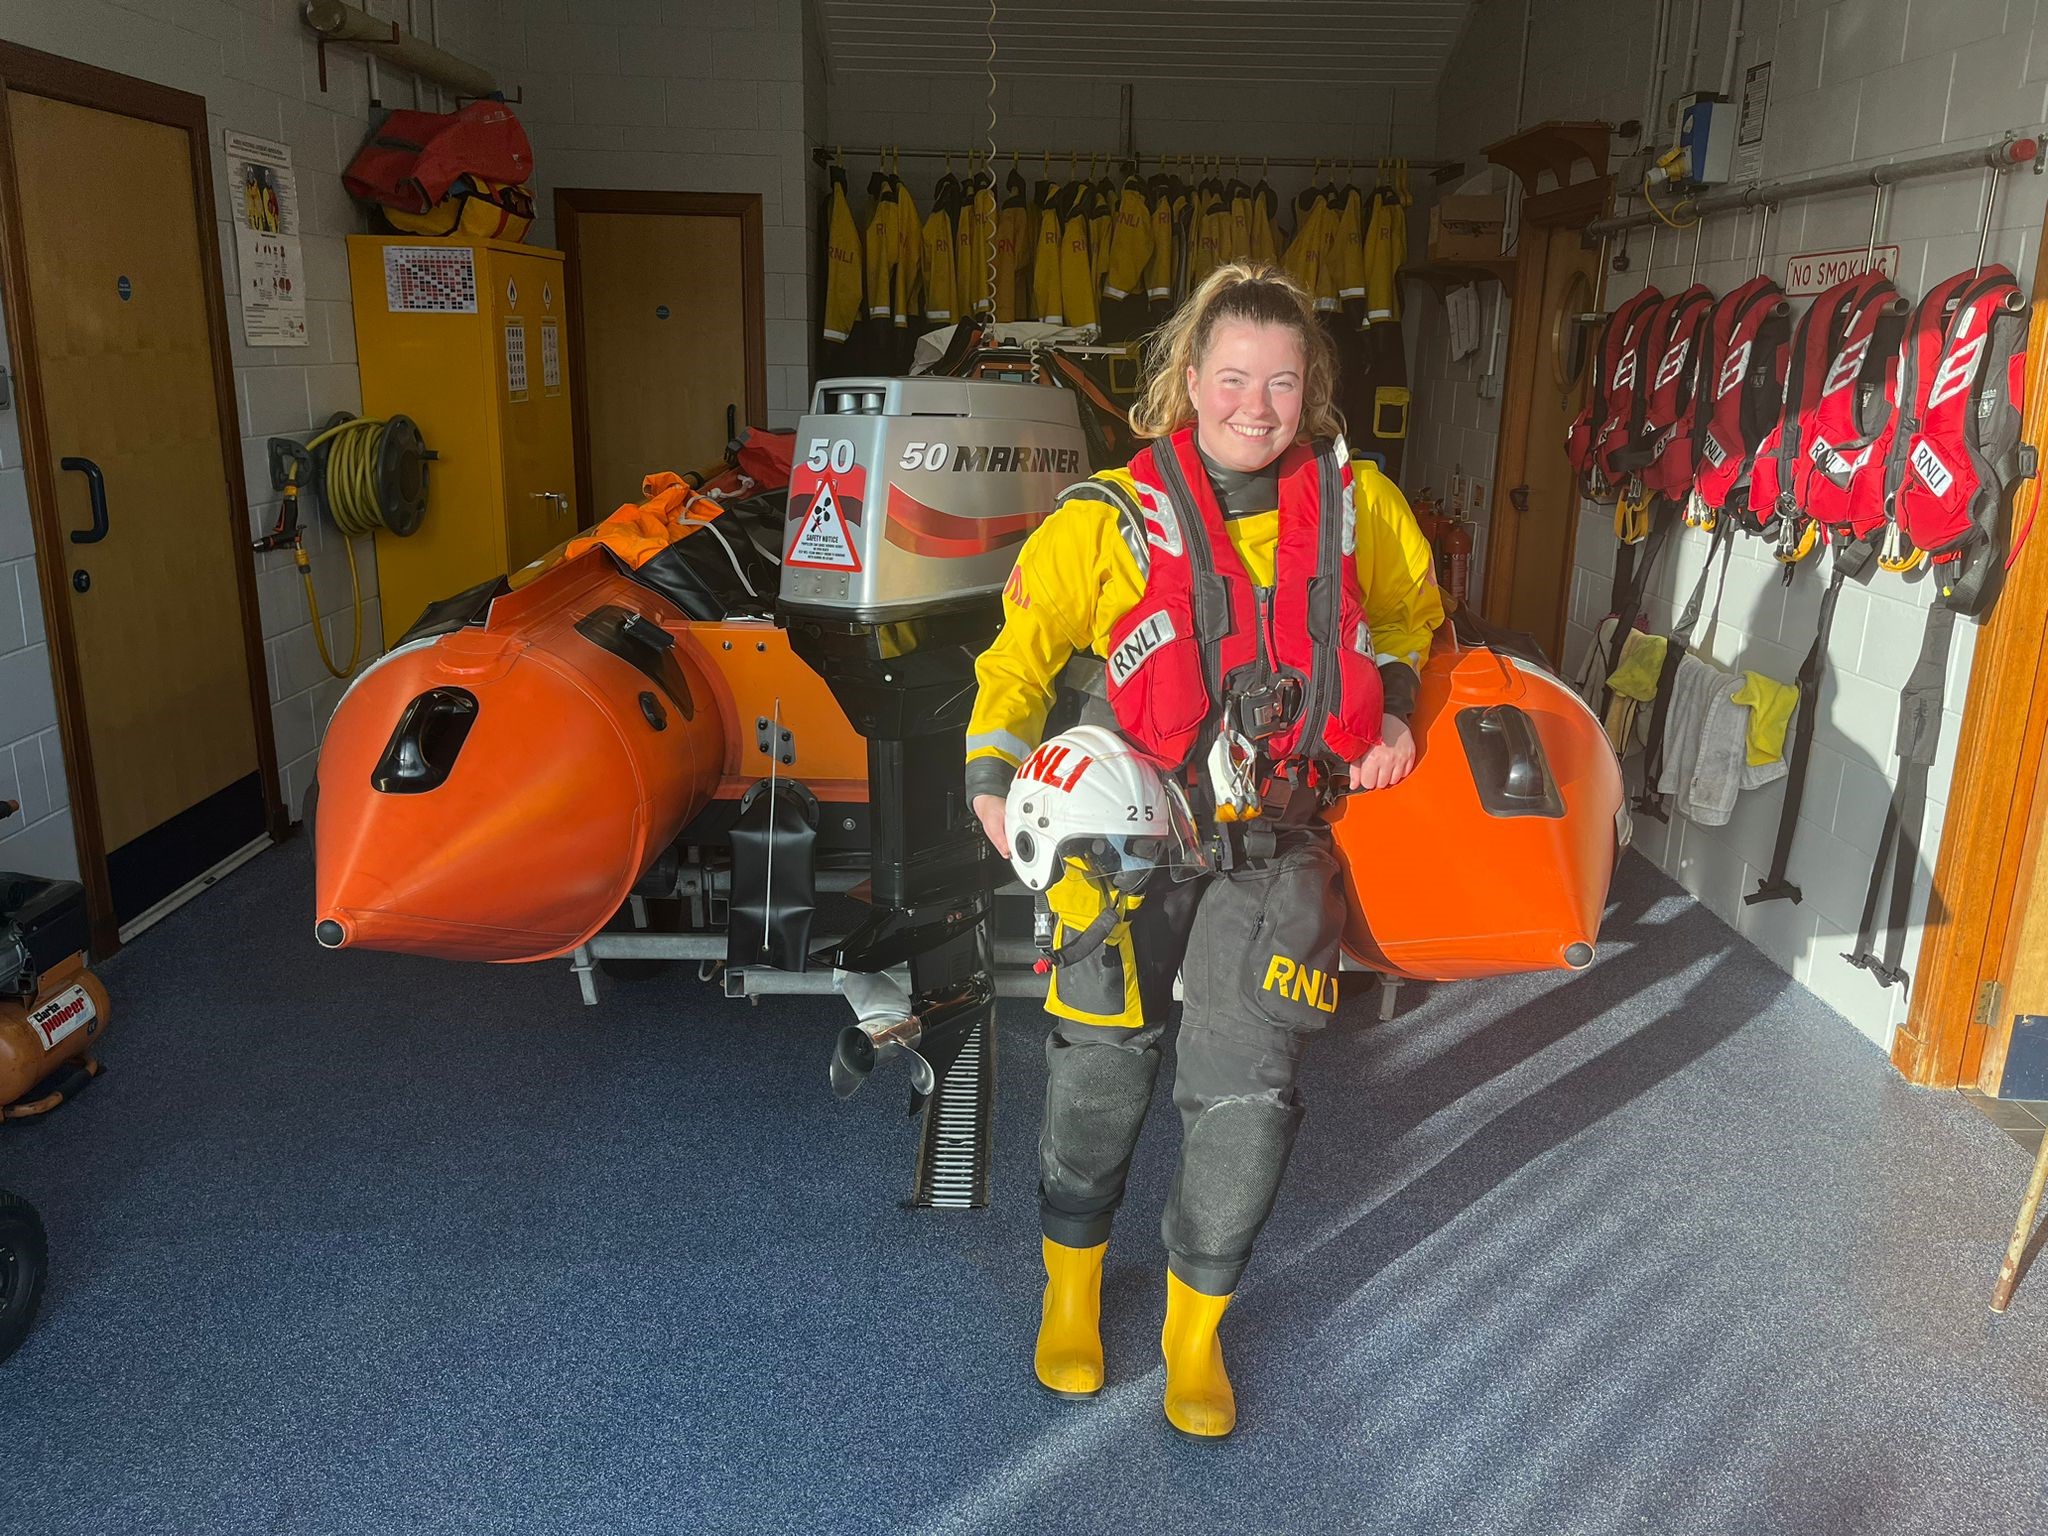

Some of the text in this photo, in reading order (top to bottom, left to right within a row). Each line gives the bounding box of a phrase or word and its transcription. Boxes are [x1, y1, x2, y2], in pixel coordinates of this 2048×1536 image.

[1792, 264, 1811, 287] NO
[806, 438, 856, 474] 50
[899, 441, 1080, 474] 50 MARINER
[1915, 448, 1947, 489] RNLI
[806, 533, 839, 544] SAFETY NOTICE
[1113, 619, 1163, 678] RNLI
[1017, 743, 1094, 794] NLI
[1126, 805, 1154, 822] 25
[1262, 954, 1339, 1014] RNLI
[33, 1002, 61, 1023] Clarke
[41, 996, 85, 1046] pioneer
